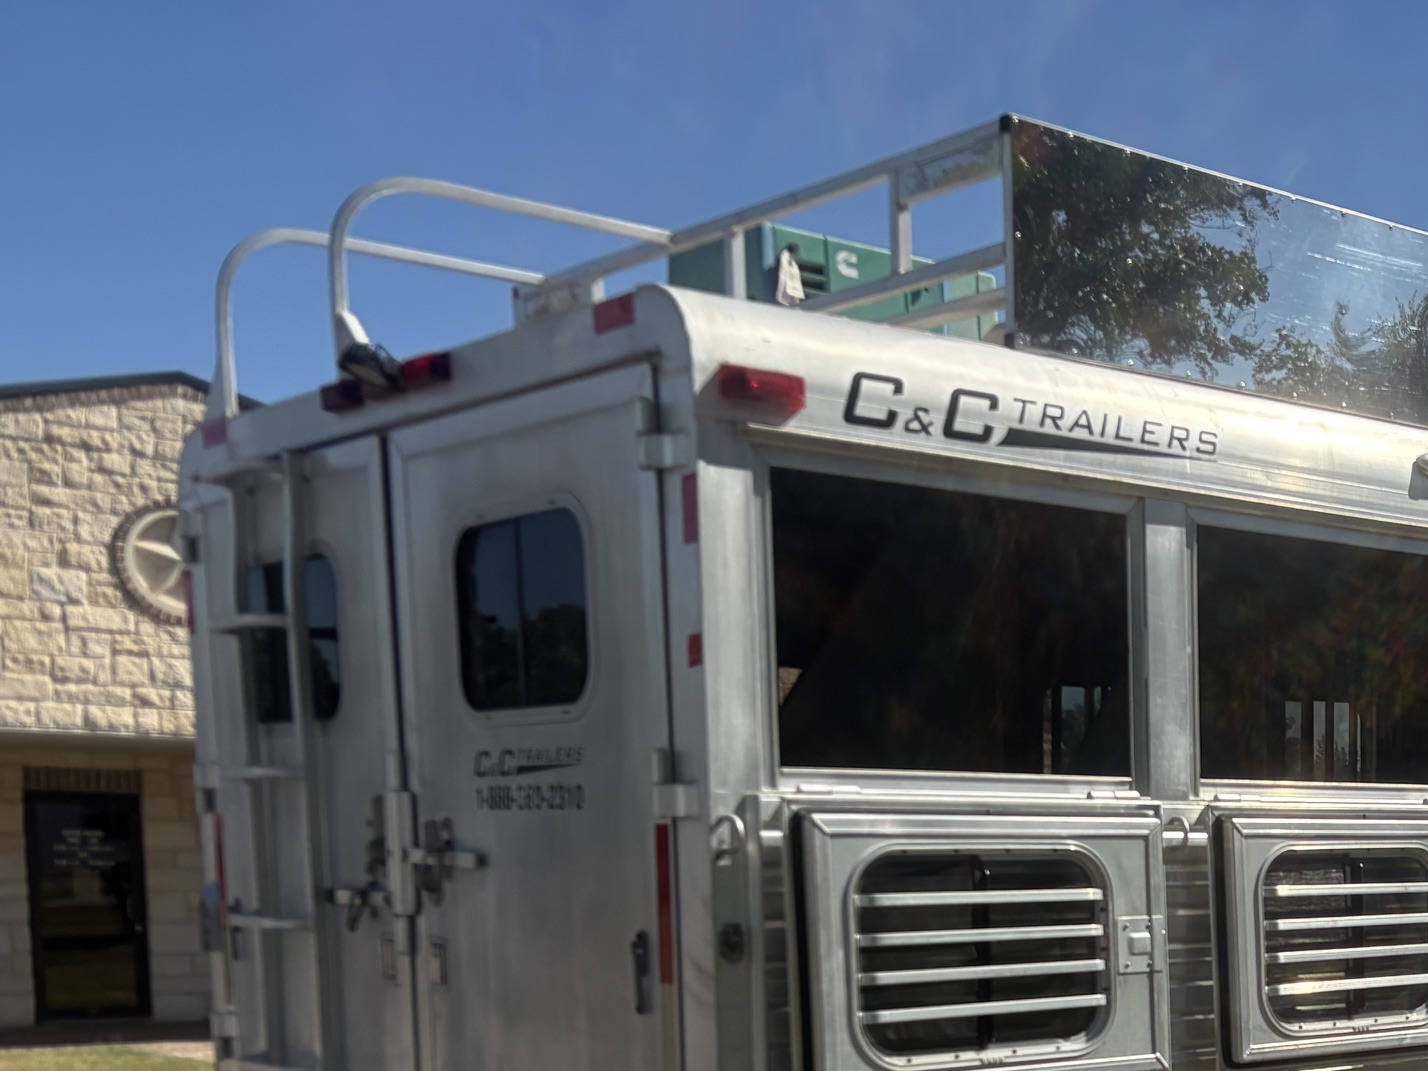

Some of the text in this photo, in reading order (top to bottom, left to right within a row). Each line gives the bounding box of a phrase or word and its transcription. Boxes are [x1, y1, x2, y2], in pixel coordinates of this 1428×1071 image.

[843, 371, 1219, 456] C&C TRAILERS
[517, 745, 585, 763] TRAILERS
